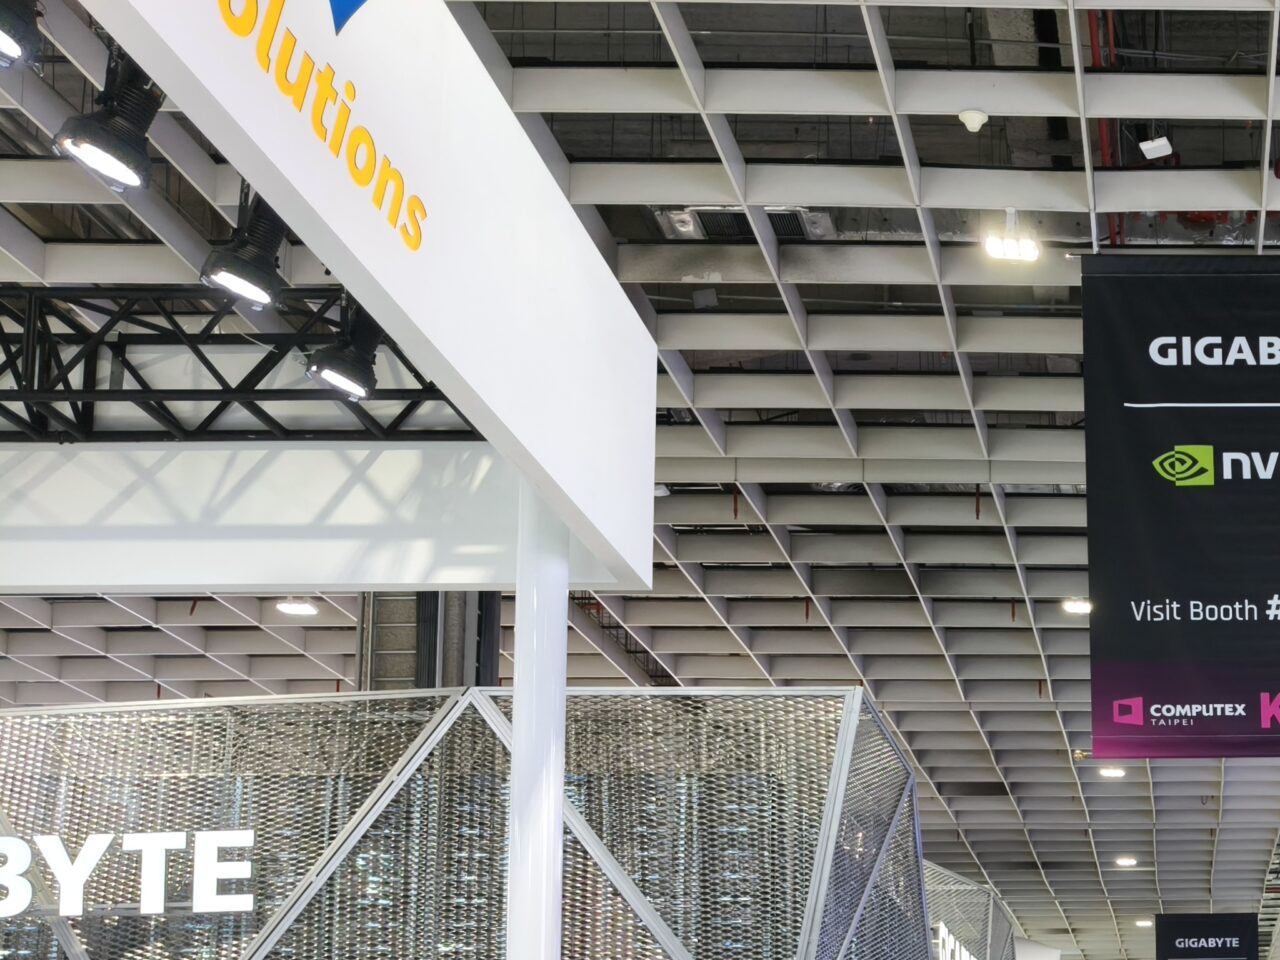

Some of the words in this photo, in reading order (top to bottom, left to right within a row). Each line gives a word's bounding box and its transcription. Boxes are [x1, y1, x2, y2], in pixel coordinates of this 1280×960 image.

[1131, 598, 1181, 621] Visit
[1190, 600, 1258, 621] Booth
[1150, 703, 1247, 718] COMPUTEX
[1151, 719, 1194, 727] TAIPEI
[1175, 938, 1240, 948] GIGABYTE
